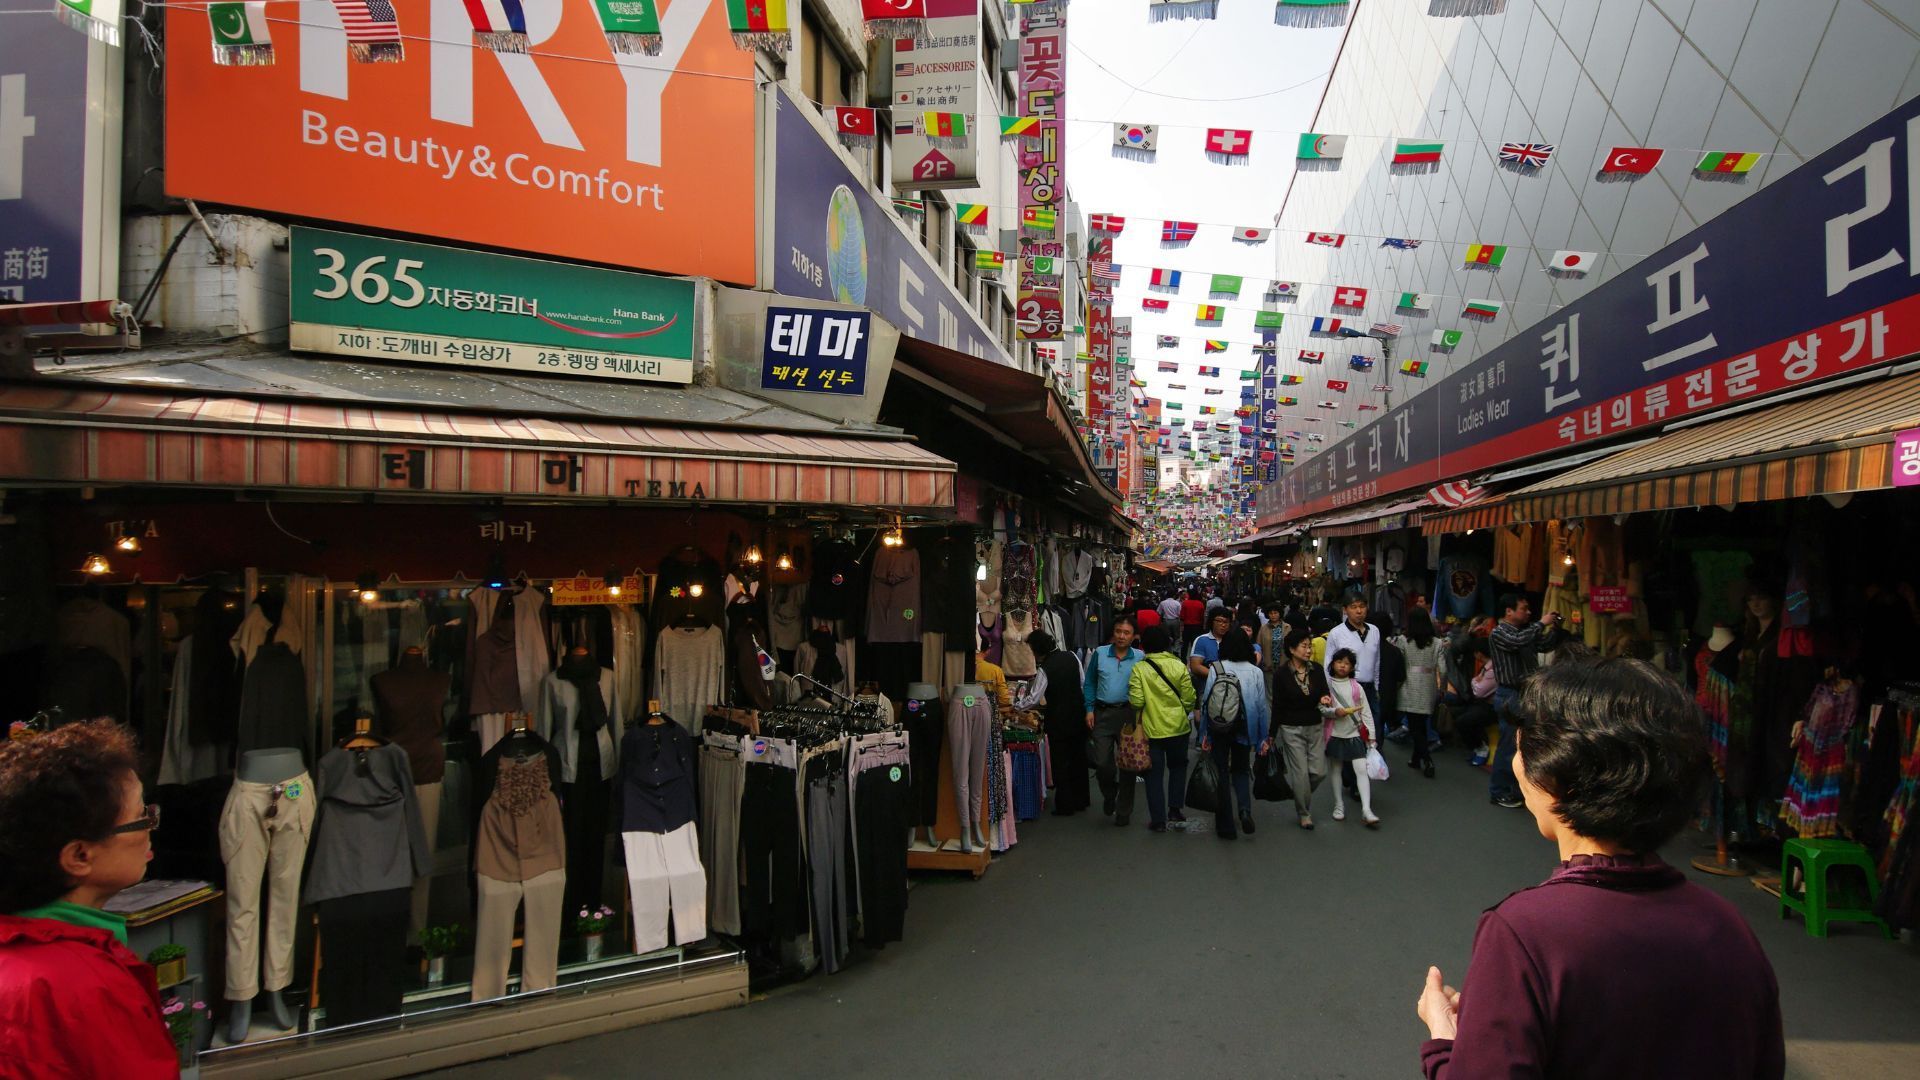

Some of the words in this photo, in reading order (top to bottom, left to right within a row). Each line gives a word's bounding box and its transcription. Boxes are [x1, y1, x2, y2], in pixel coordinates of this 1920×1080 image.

[914, 60, 975, 75] ACCESSORIES
[916, 84, 971, 96] アクセサリー
[302, 109, 463, 180] Beauty
[505, 153, 664, 211] Comfort
[921, 159, 949, 179] 2F
[791, 246, 823, 288] 지하1층
[313, 247, 425, 308] 365
[427, 286, 538, 318] 자동화코너
[546, 310, 622, 325] www.hanabank.com
[613, 308, 639, 320] Hana
[641, 311, 665, 323] Bank
[771, 314, 863, 360] 테마
[443, 341, 511, 363] 수입상가
[604, 356, 661, 376] 액세서리
[772, 366, 809, 387] 패션
[818, 369, 854, 389] 선두
[1457, 407, 1484, 434] Ladies
[1486, 398, 1511, 423] Wear
[625, 480, 707, 499] TEMA
[479, 521, 536, 543] 테마
[556, 577, 640, 592] 天國の段
